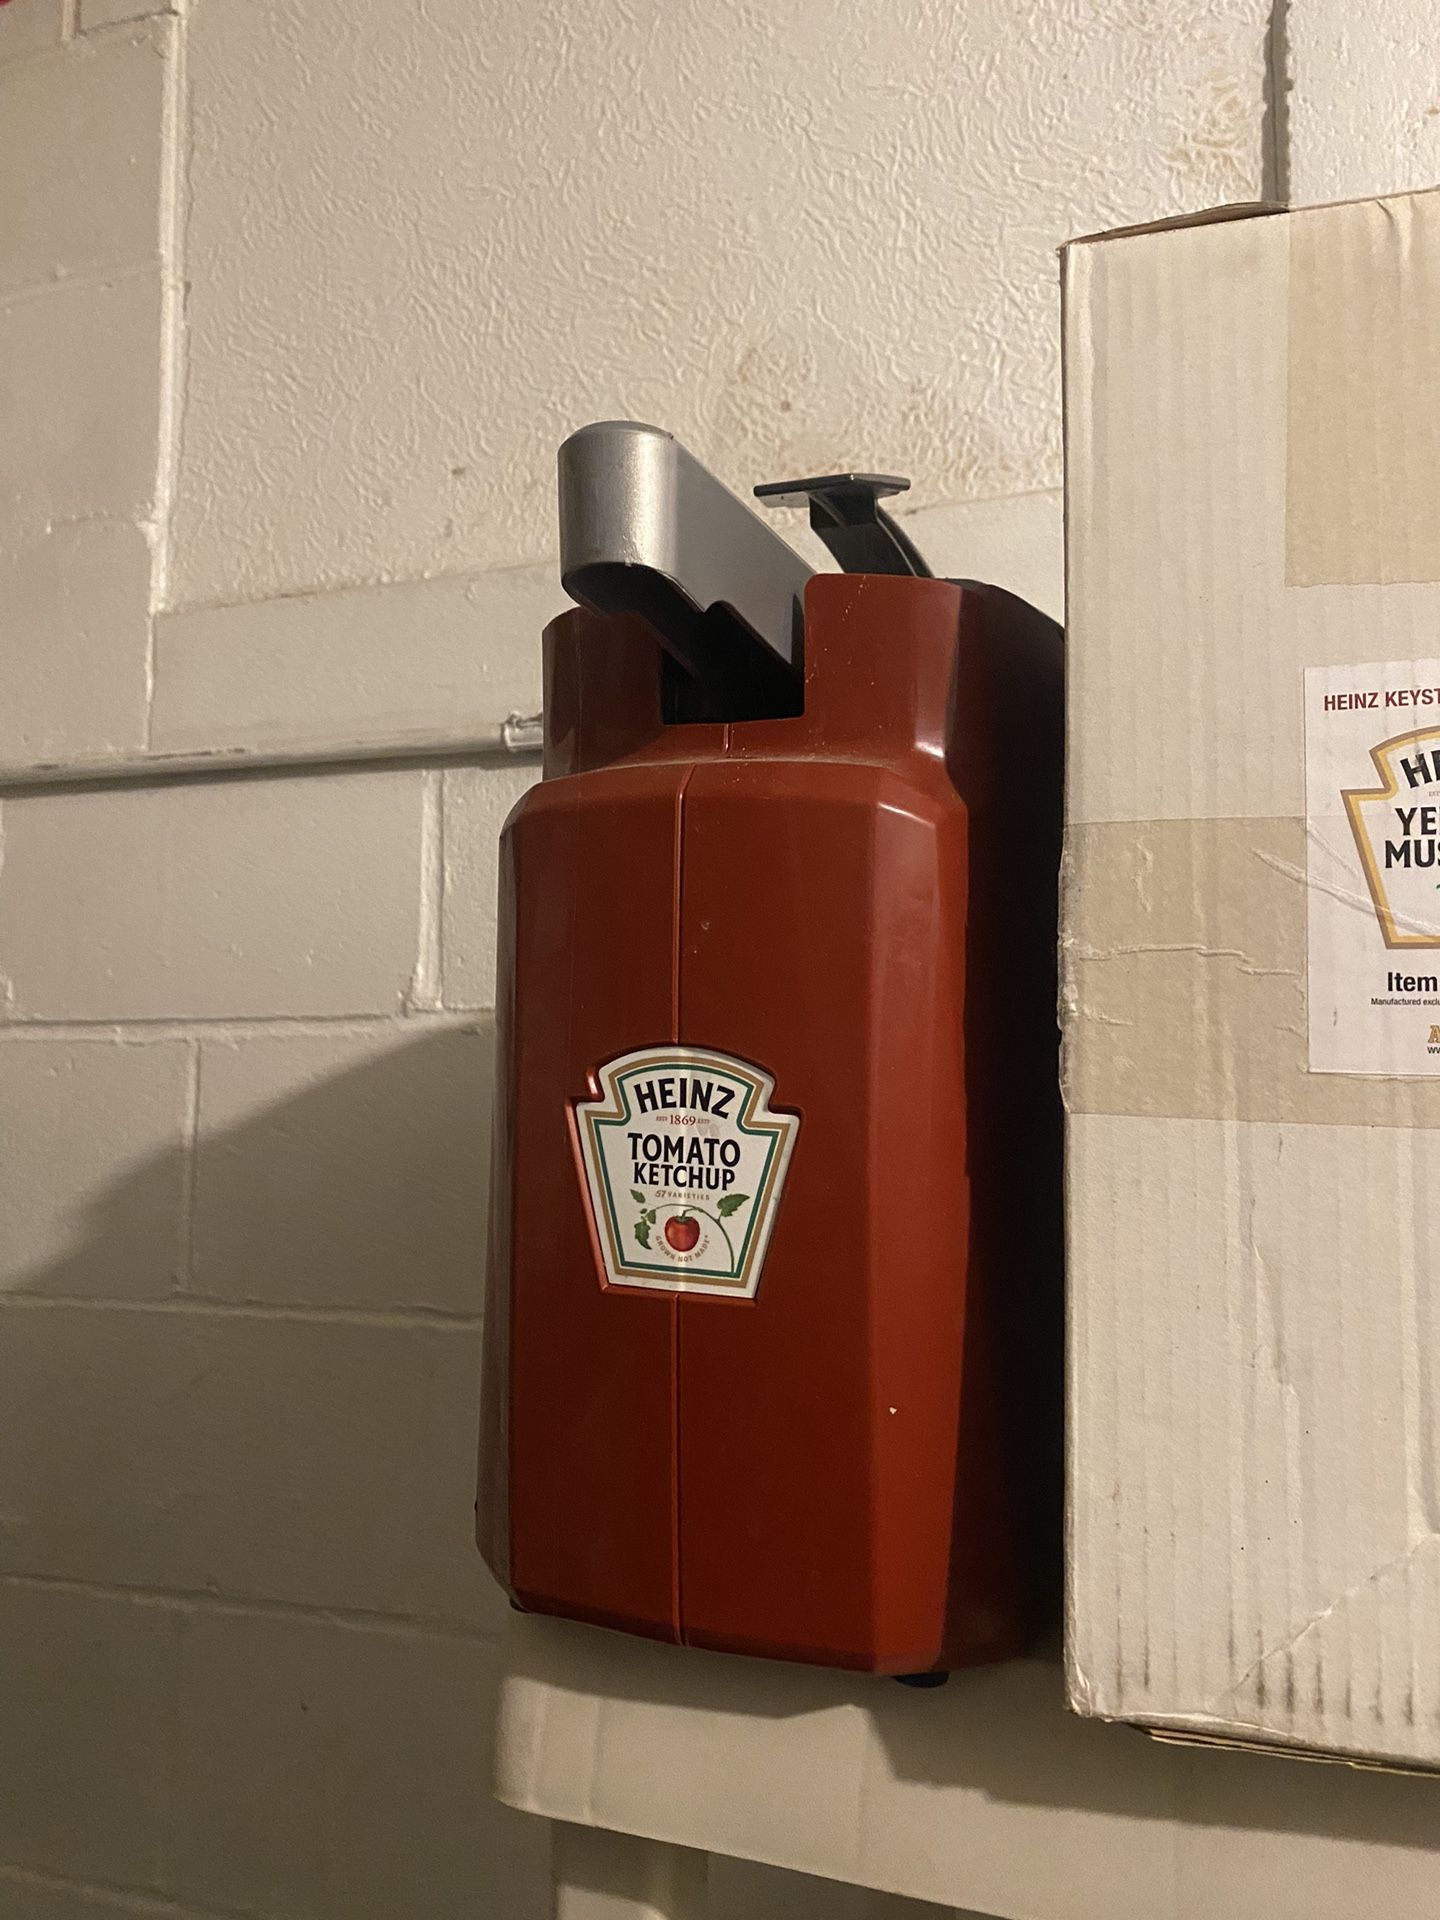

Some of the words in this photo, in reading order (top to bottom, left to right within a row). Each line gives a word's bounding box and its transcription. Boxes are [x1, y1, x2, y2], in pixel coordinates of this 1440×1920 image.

[1324, 692, 1379, 711] HEINZ
[1395, 807, 1440, 836] YE
[1385, 839, 1440, 868] MU
[1387, 972, 1438, 992] Item
[1370, 998, 1421, 1006] Manufactured
[633, 1078, 735, 1119] HEINZ
[670, 1114, 696, 1125] 1869
[627, 1132, 741, 1168] TOMATO
[633, 1162, 735, 1191] KETCHUP
[655, 1190, 666, 1198] 57
[668, 1192, 710, 1200] VARIETIES
[655, 1235, 676, 1260] GROWN
[677, 1254, 693, 1262] NOT
